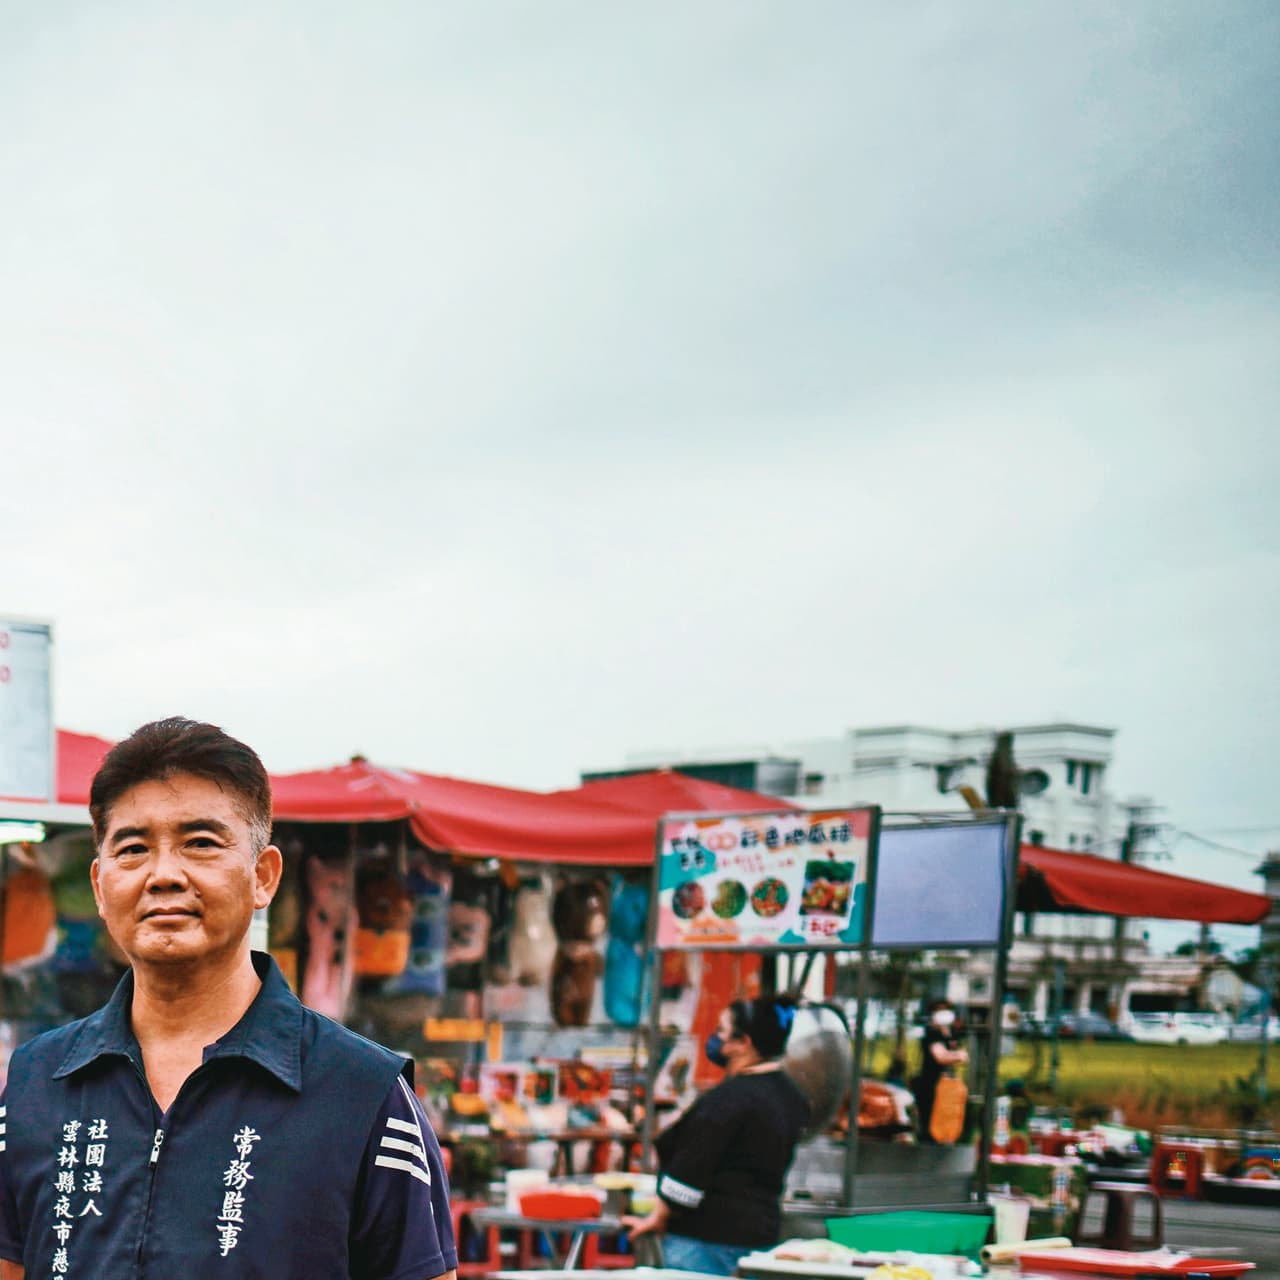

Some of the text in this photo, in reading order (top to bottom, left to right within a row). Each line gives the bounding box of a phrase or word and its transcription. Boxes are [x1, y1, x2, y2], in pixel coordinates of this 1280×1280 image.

[79, 1118, 109, 1217] 社團法人
[216, 1125, 261, 1257] 常務監事
